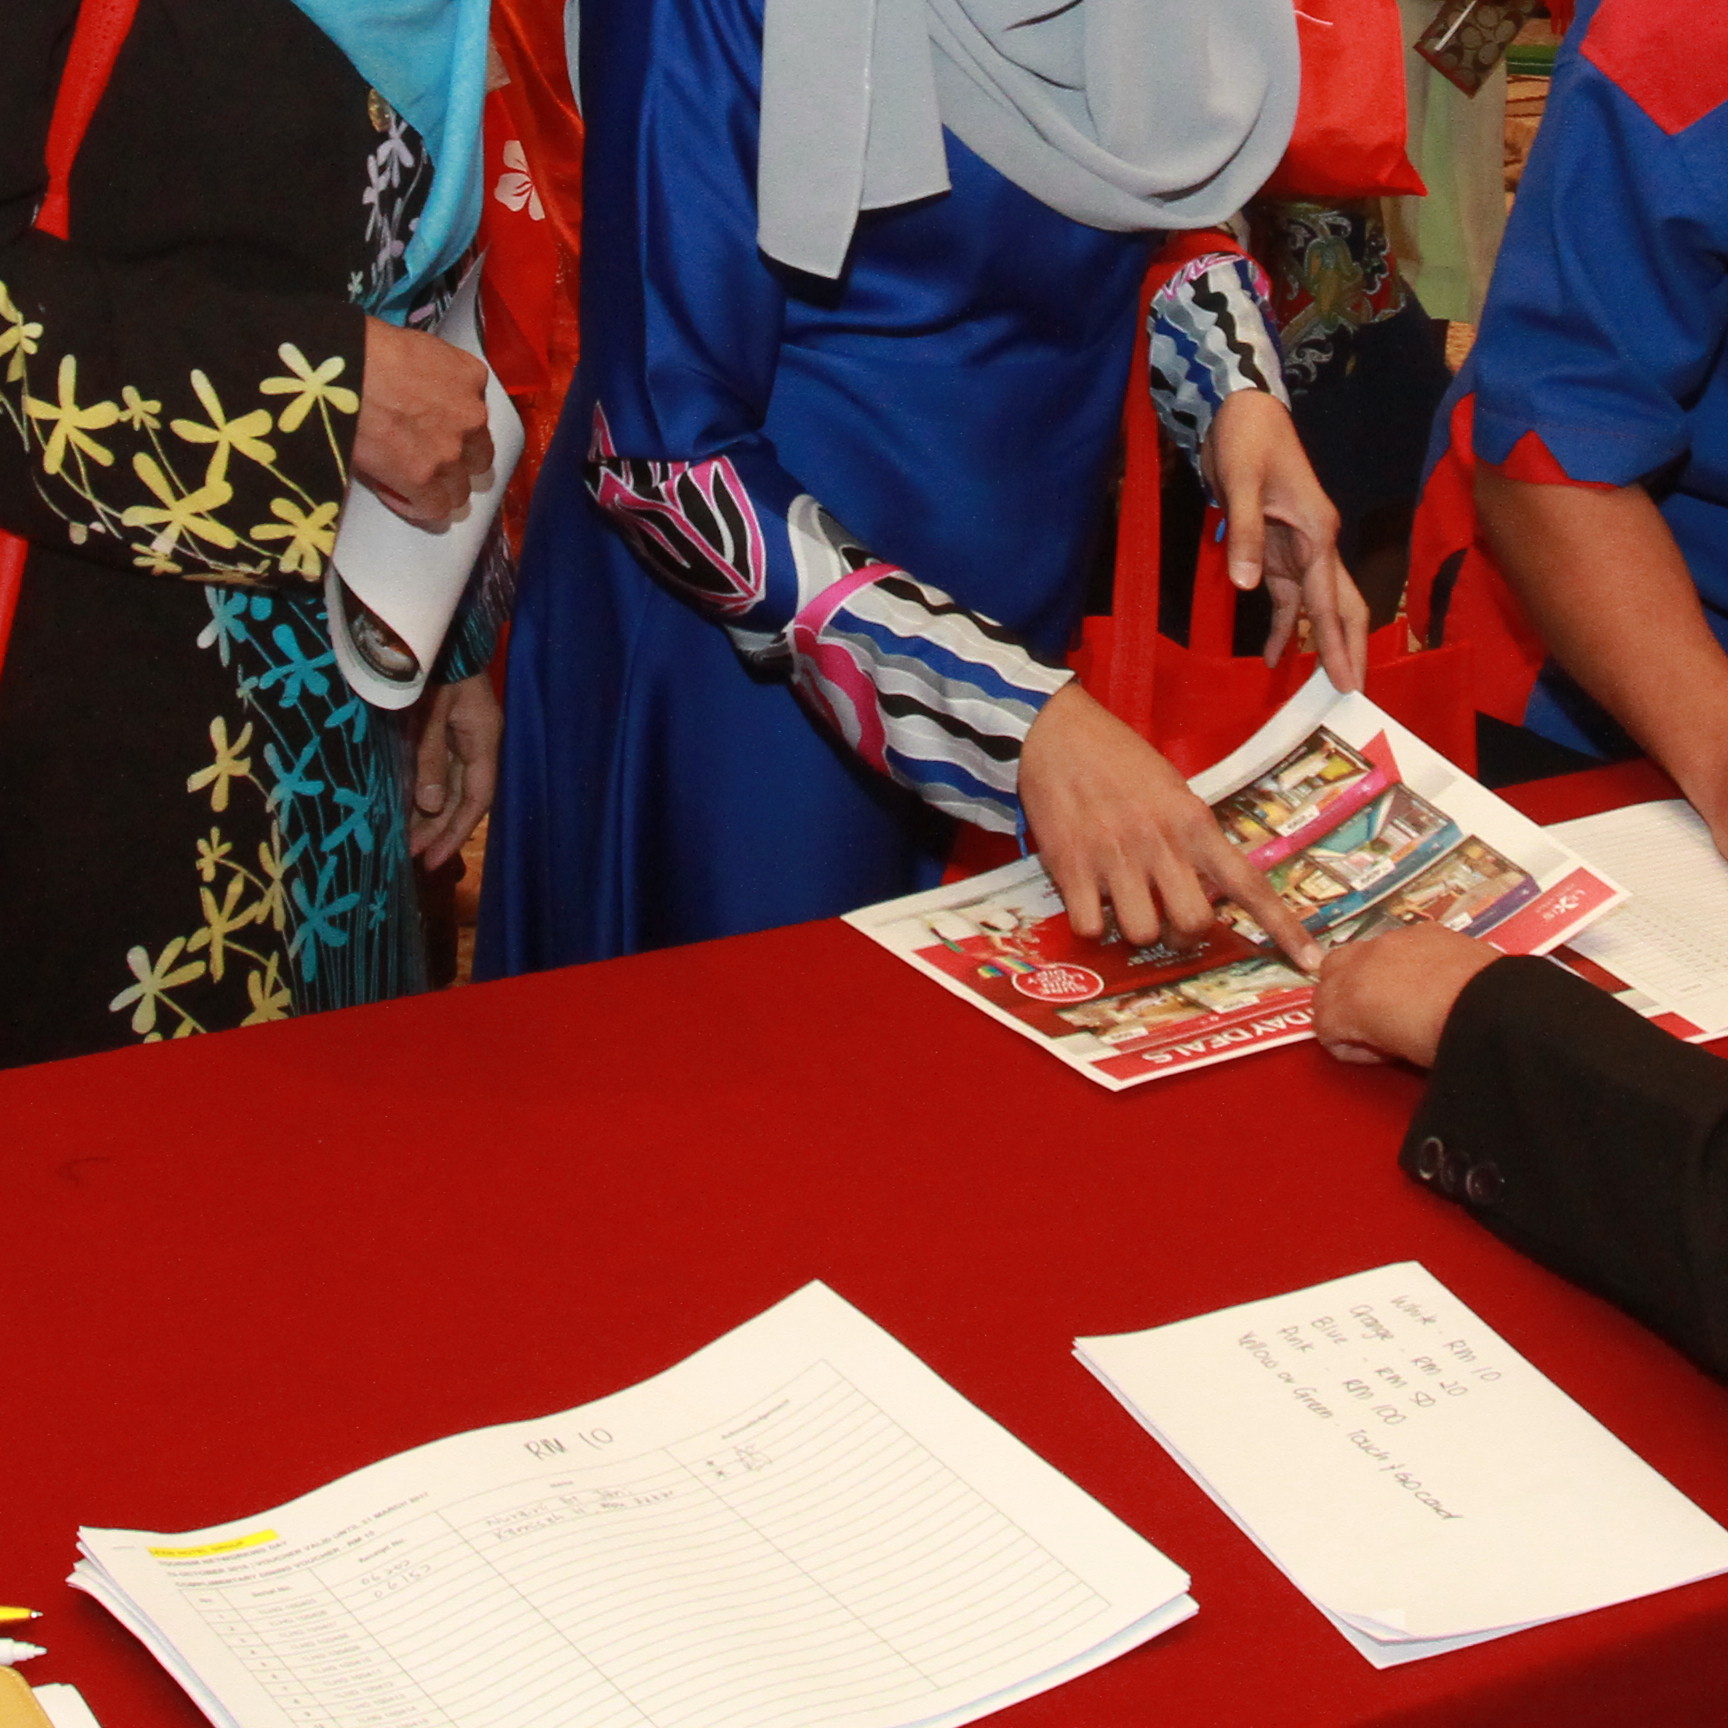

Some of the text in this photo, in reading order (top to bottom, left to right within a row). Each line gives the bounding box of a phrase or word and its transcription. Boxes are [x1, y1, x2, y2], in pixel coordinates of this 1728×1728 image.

[1141, 1010, 1313, 1064] DAY DEALS
[1277, 1325, 1407, 1426] Pink RM 100
[1309, 1315, 1349, 1346] Blue
[1373, 1366, 1407, 1390] RM
[1348, 1304, 1469, 1398] Orange RM 20
[1390, 1293, 1502, 1383] White RM 10
[578, 1427, 614, 1450] 10
[1236, 1331, 1278, 1369] Yellow
[1291, 1387, 1335, 1421] Green
[1346, 1428, 1390, 1464] Touch
